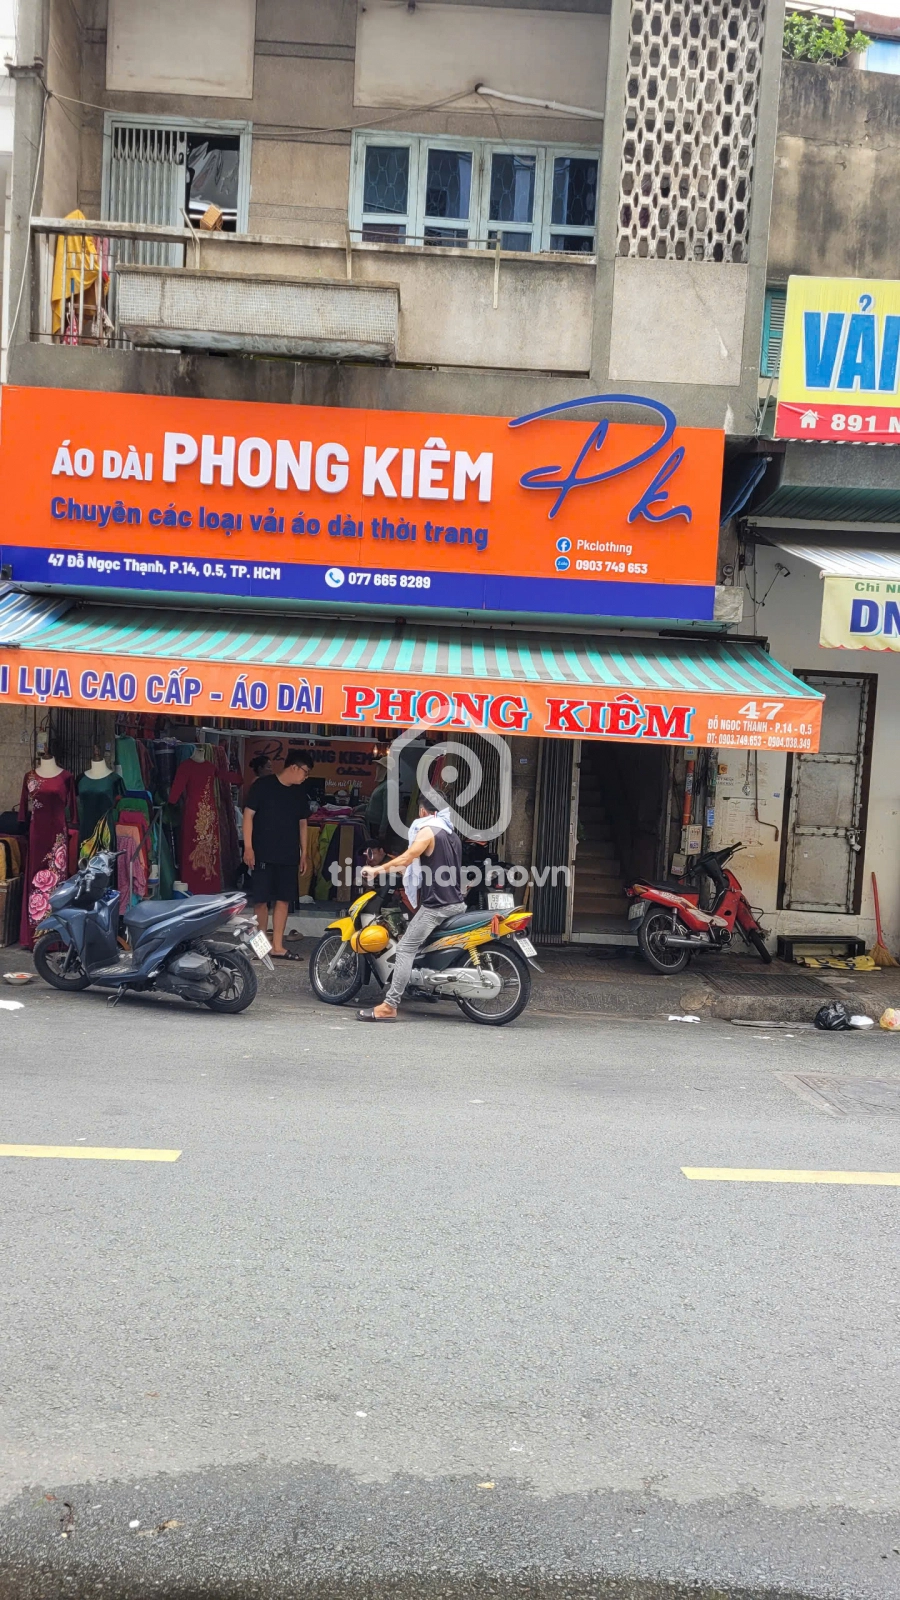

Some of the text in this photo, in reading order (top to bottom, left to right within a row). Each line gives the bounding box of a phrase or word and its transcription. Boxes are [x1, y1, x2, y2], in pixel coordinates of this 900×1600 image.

[803, 294, 900, 393] VẢI
[830, 413, 876, 432] 891
[51, 431, 493, 503] ÁO DÀI PHONG KIÊM
[51, 496, 489, 551] Chuyên các loại vải áo dài thời trang
[576, 539, 633, 556] Pkclothing
[48, 553, 281, 581] 47 Đỗ Ngọc Thạnh, P.14, Q.5, TP. HCM
[575, 559, 648, 574] 0903 749 653
[348, 572, 431, 589] 077 665 8289
[855, 582, 900, 594] Chi N
[18, 666, 72, 702] LỤA
[80, 669, 137, 703] CAO
[146, 667, 202, 706] CẤP
[230, 674, 269, 711] ÁO
[277, 677, 323, 714] DÀI
[341, 685, 532, 733] PHONG
[545, 692, 695, 741] KIÊM
[738, 701, 785, 720] 47
[708, 715, 719, 730] ĐỖ
[720, 719, 741, 734] NGỌC
[743, 720, 768, 734] THẠNH
[775, 722, 793, 733] P.14
[800, 723, 812, 735] Q.5
[707, 732, 718, 744] ĐT:
[718, 733, 762, 747] 0903.749.653
[767, 735, 811, 749] 0904.038.349
